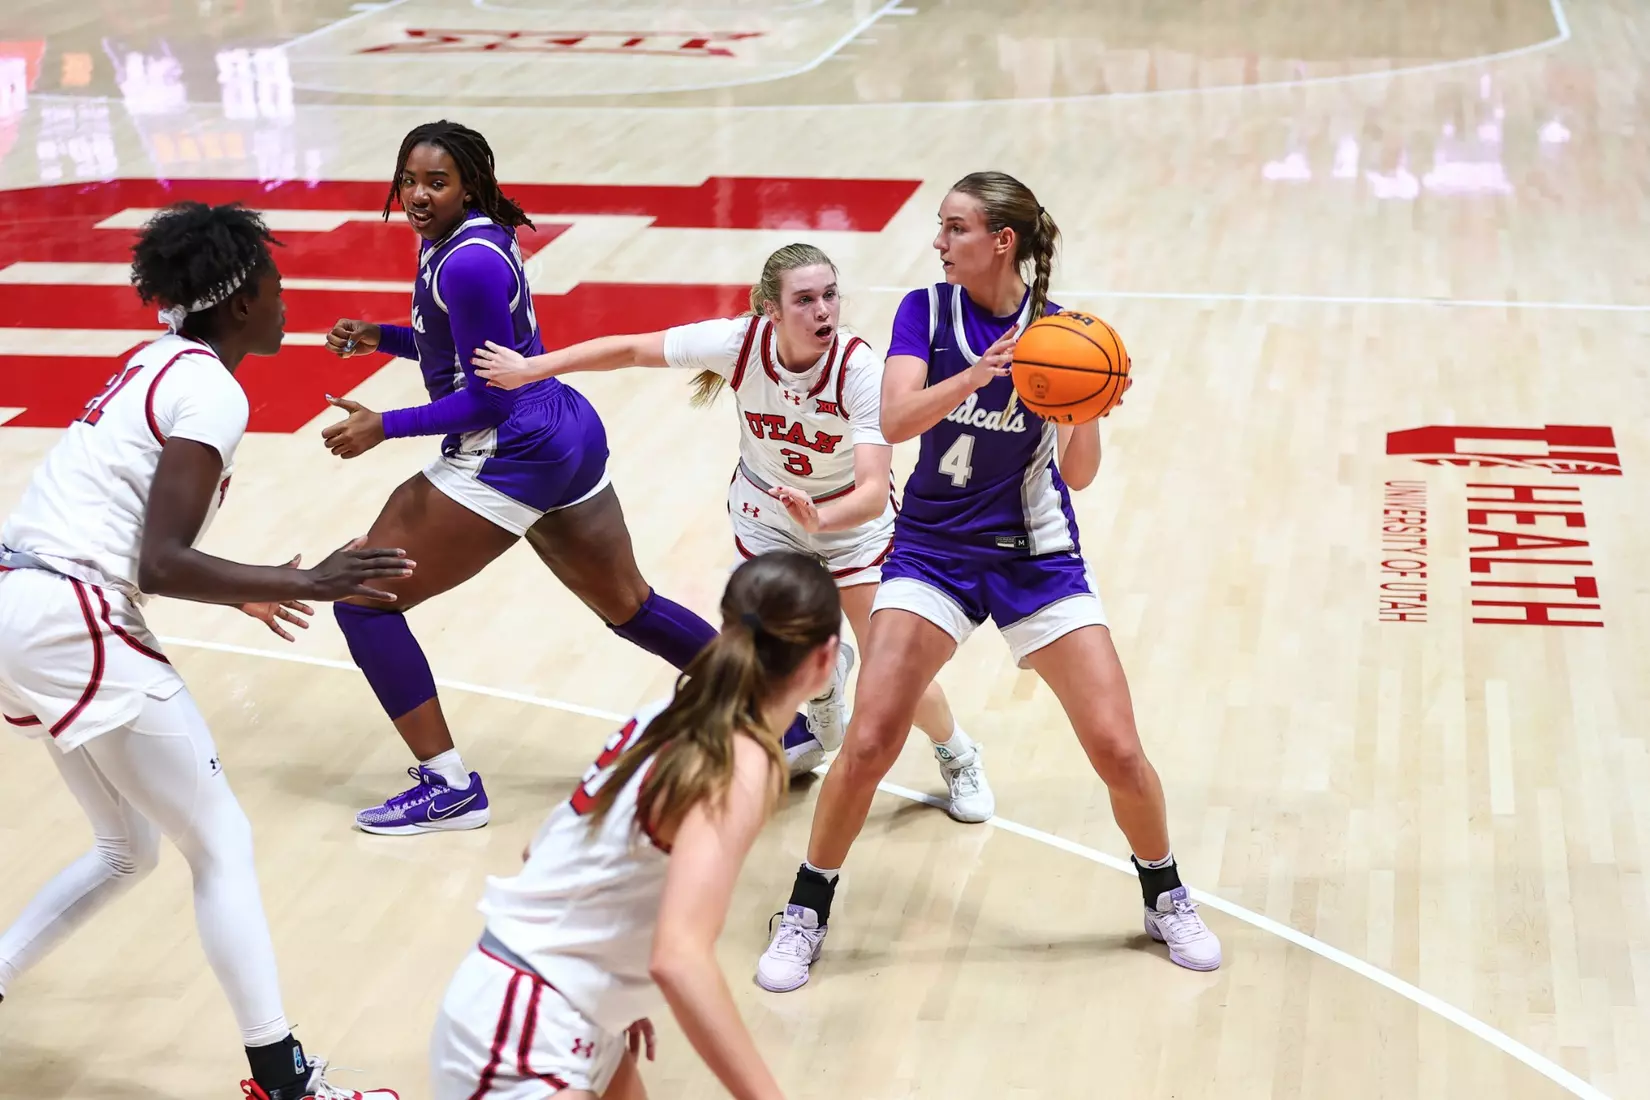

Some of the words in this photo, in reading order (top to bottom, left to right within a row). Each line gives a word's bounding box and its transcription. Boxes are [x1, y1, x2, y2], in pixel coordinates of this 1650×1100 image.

[818, 400, 837, 415] XII
[945, 392, 1027, 433] dcats
[744, 411, 843, 453] UTAH
[780, 448, 813, 476] 3
[938, 433, 975, 488] 4
[1381, 480, 1427, 556] UNIVERSITY
[1380, 559, 1427, 578] OF
[1466, 483, 1604, 627] HEALTH
[1379, 582, 1427, 622] UTAH
